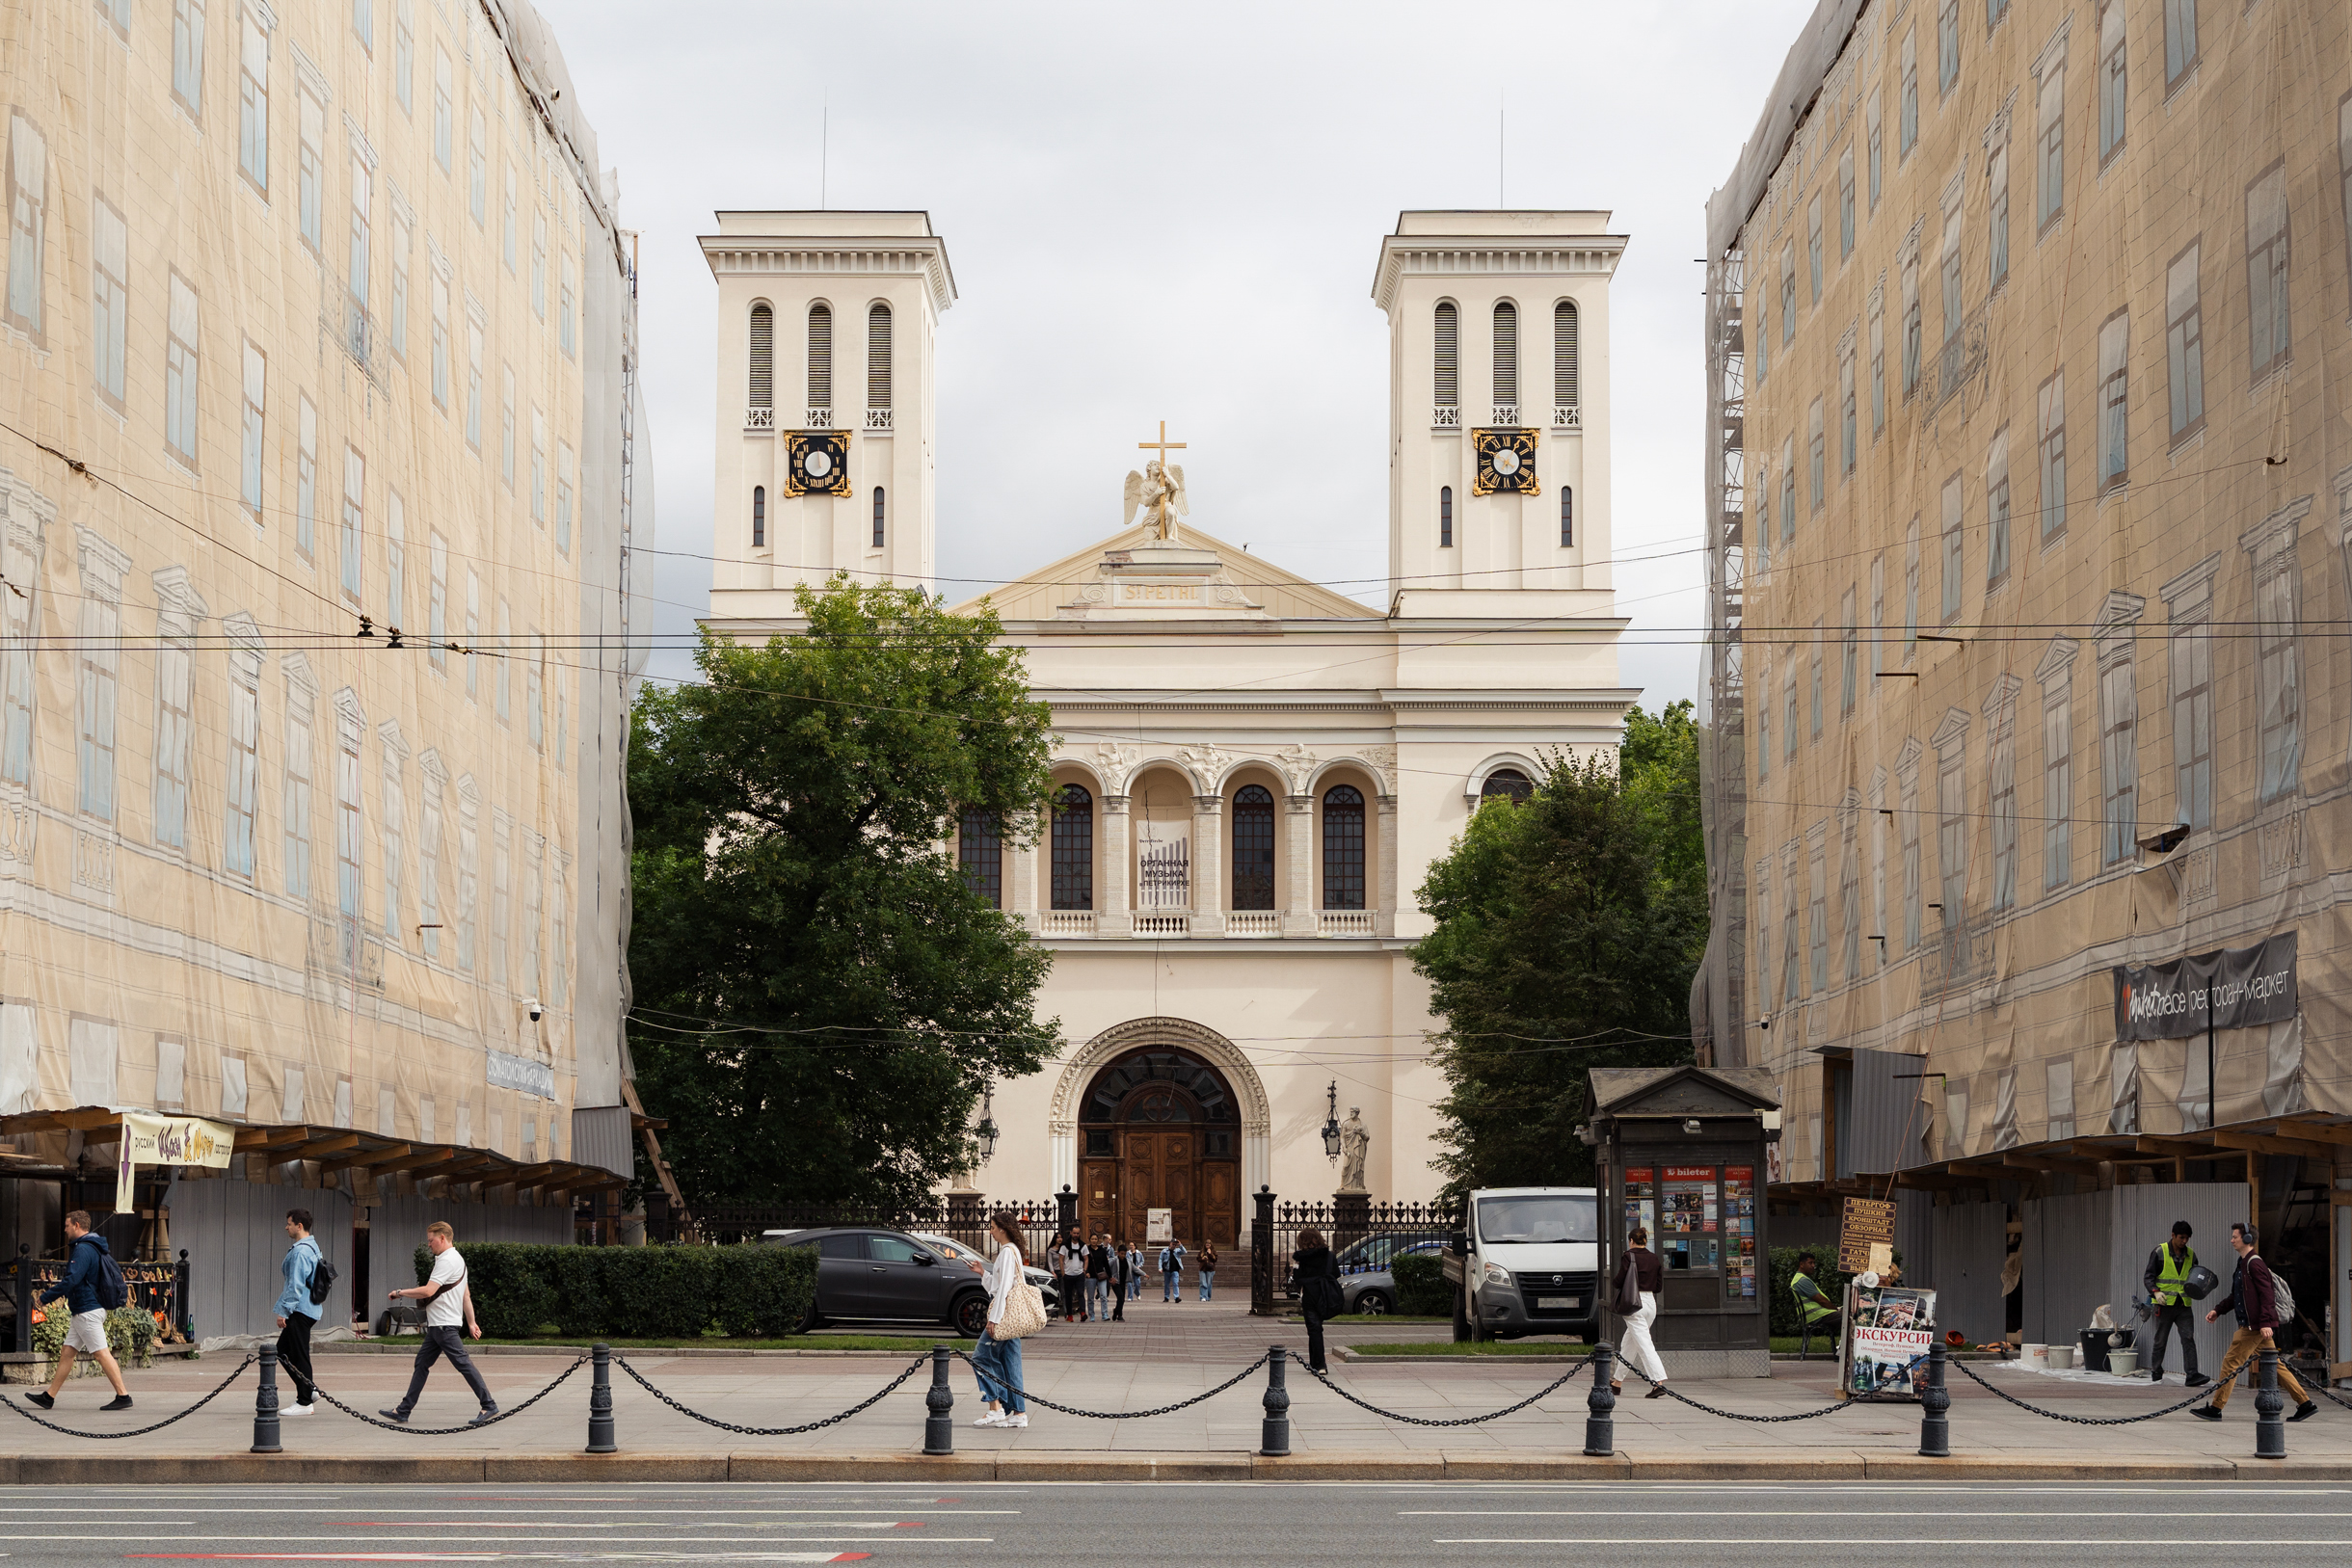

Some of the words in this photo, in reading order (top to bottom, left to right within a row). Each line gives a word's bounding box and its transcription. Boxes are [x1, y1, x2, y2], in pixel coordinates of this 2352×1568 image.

[135, 1134, 155, 1152] русский
[158, 1122, 182, 1162] Иван
[1851, 1199, 1891, 1209] ПЕТЕРГОФ
[1854, 1208, 1886, 1217] ПУШКИН
[1848, 1216, 1890, 1225] КРОНШТАДТ
[1849, 1224, 1887, 1233] ОБЗОРНАЯ
[1856, 1329, 1933, 1345] ЭКСКУРСИИ
